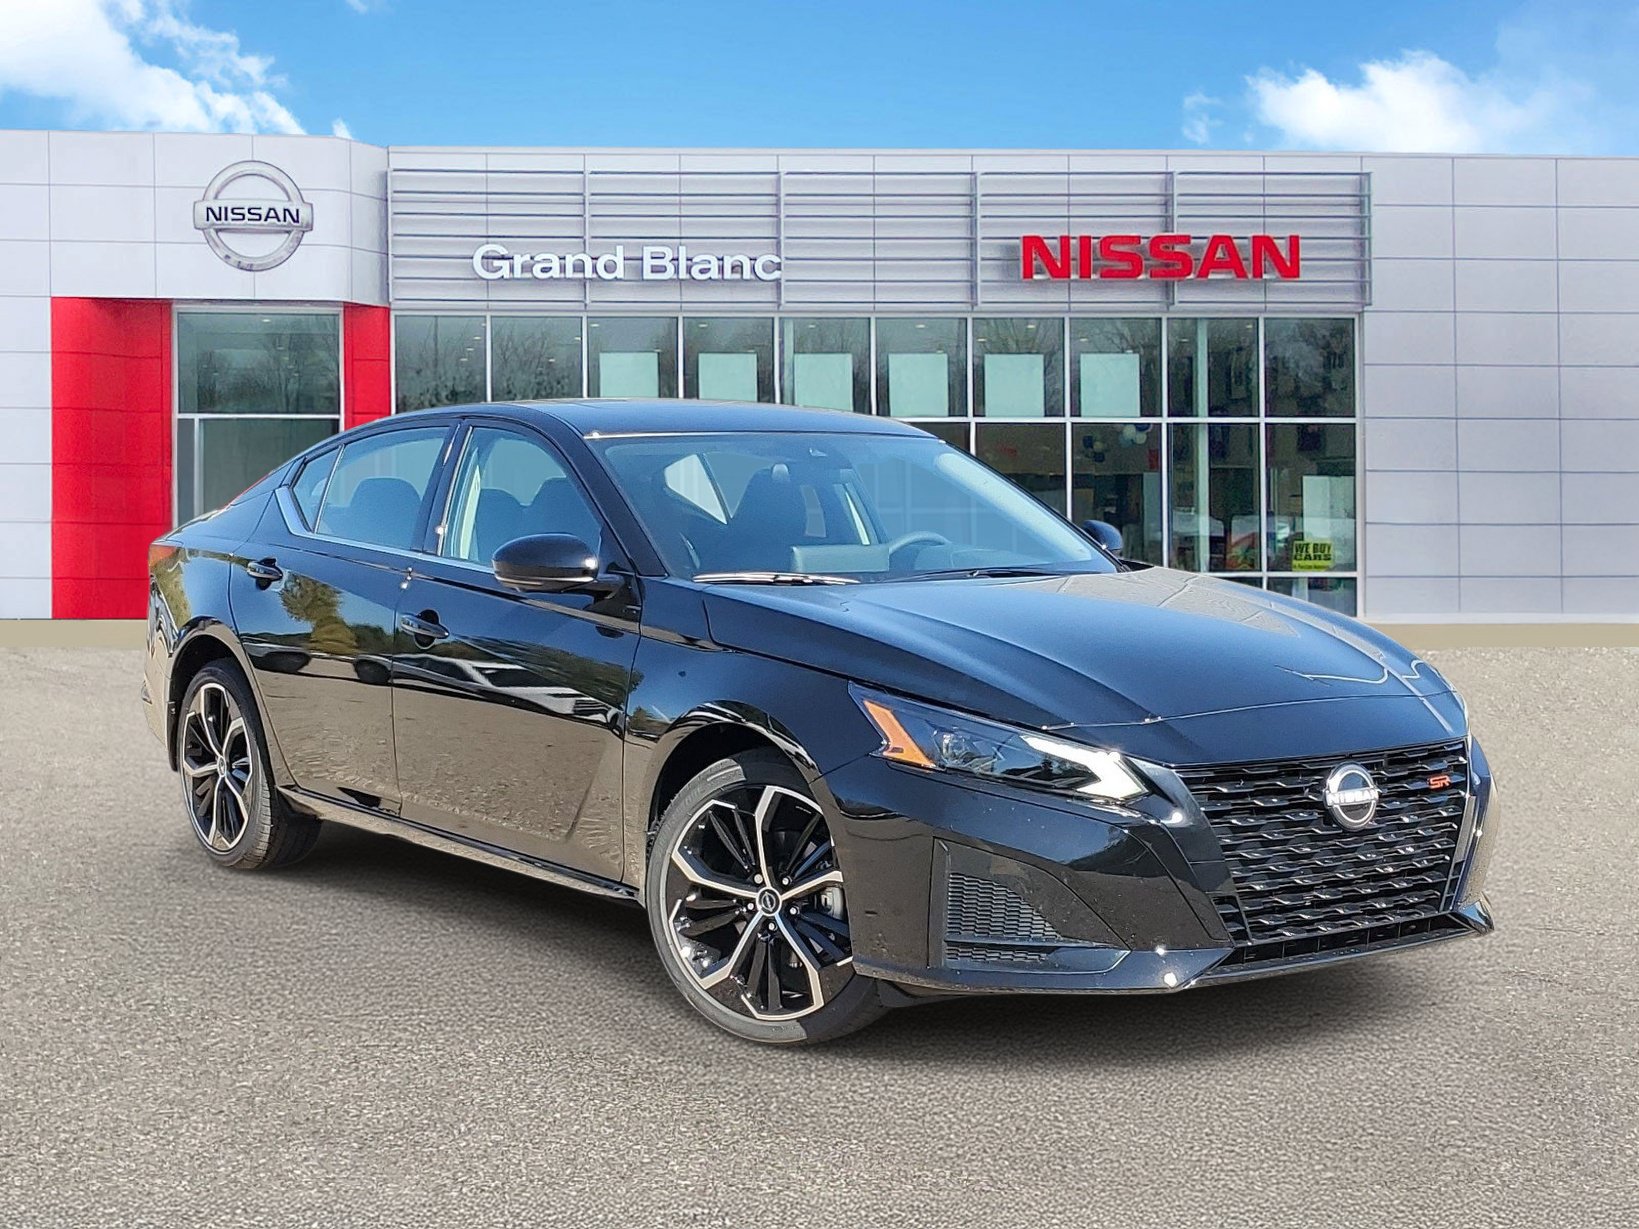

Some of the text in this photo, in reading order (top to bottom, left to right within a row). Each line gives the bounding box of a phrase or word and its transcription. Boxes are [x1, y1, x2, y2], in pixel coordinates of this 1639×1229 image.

[206, 205, 300, 224] NISSAN
[472, 243, 783, 280] Grand Blanc
[1021, 234, 1300, 280] NISSAN
[1294, 542, 1332, 553] WE BUY
[1293, 553, 1332, 561] CARS
[1429, 775, 1451, 789] SR
[1327, 788, 1376, 805] NISSAN
